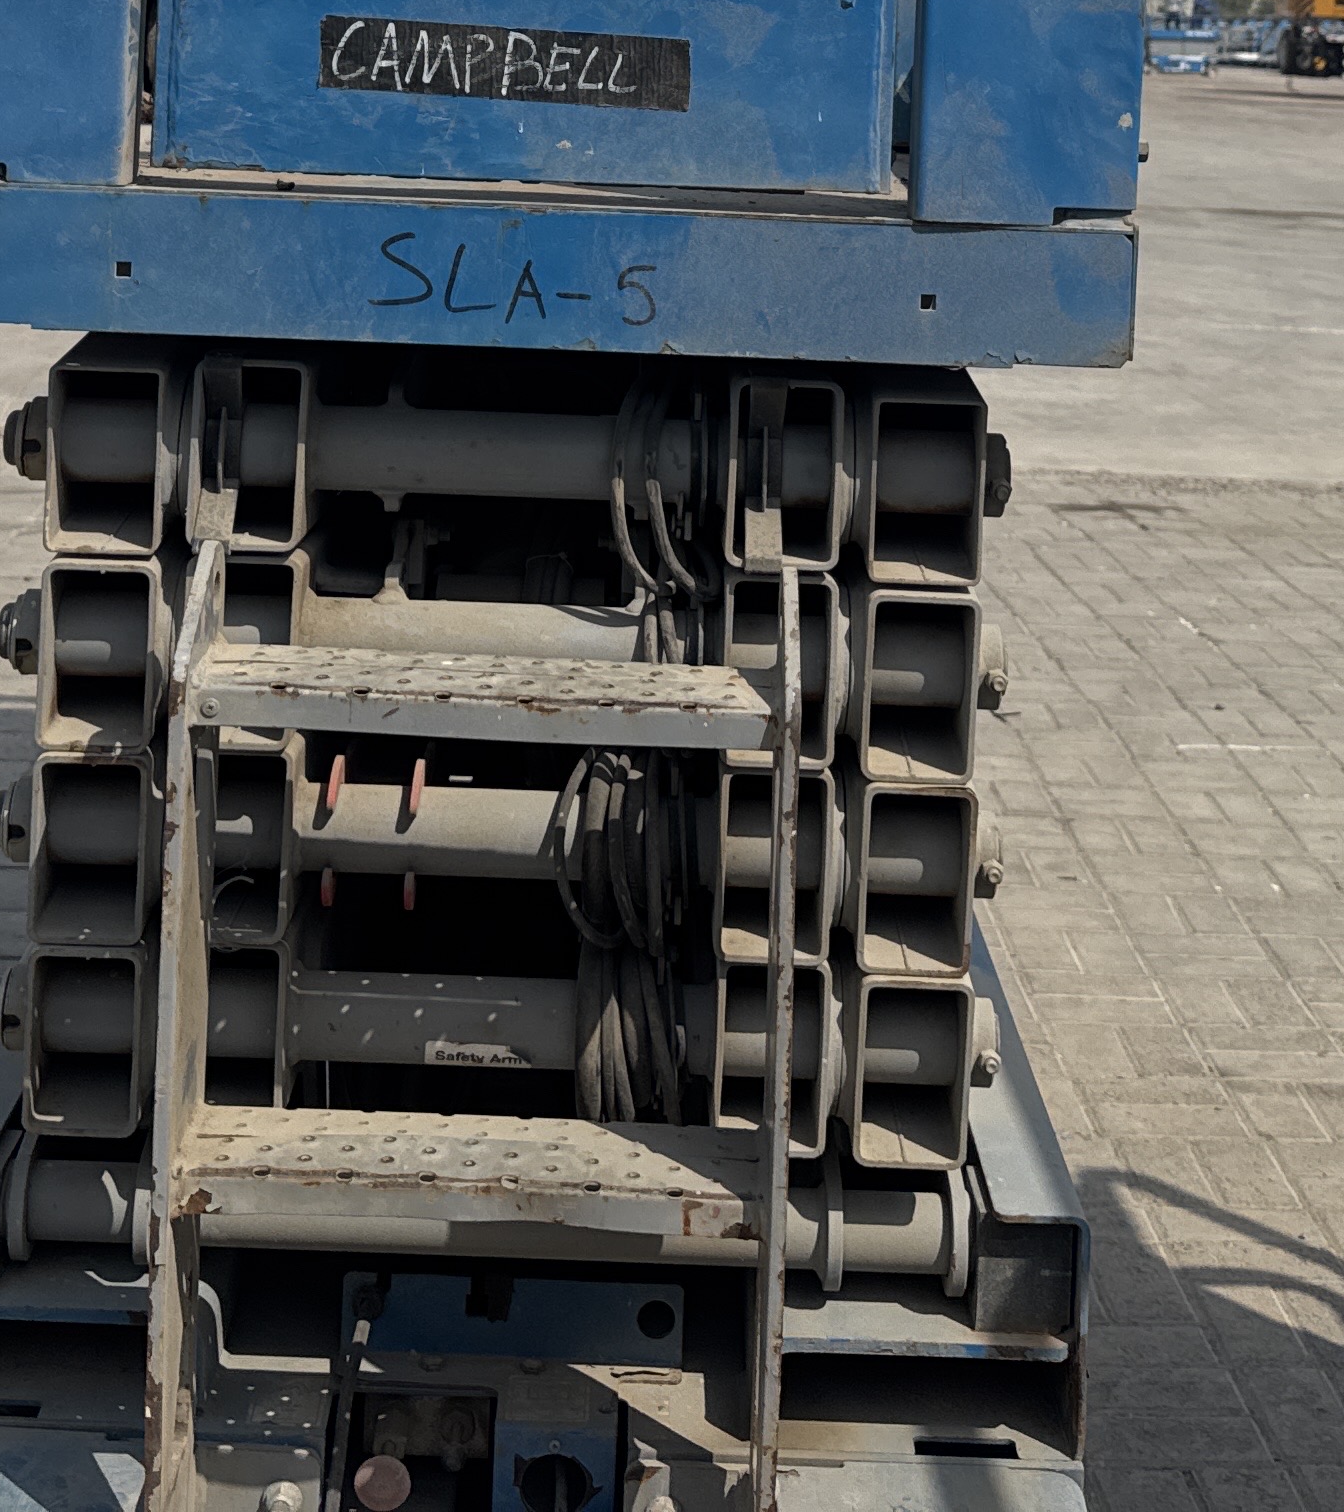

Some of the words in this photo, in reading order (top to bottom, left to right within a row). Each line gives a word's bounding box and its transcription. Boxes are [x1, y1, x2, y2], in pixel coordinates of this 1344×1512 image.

[331, 20, 637, 95] CAMPBELL
[367, 232, 656, 326] SLA-5
[435, 1050, 485, 1064] Safety
[489, 1054, 523, 1065] Arm
